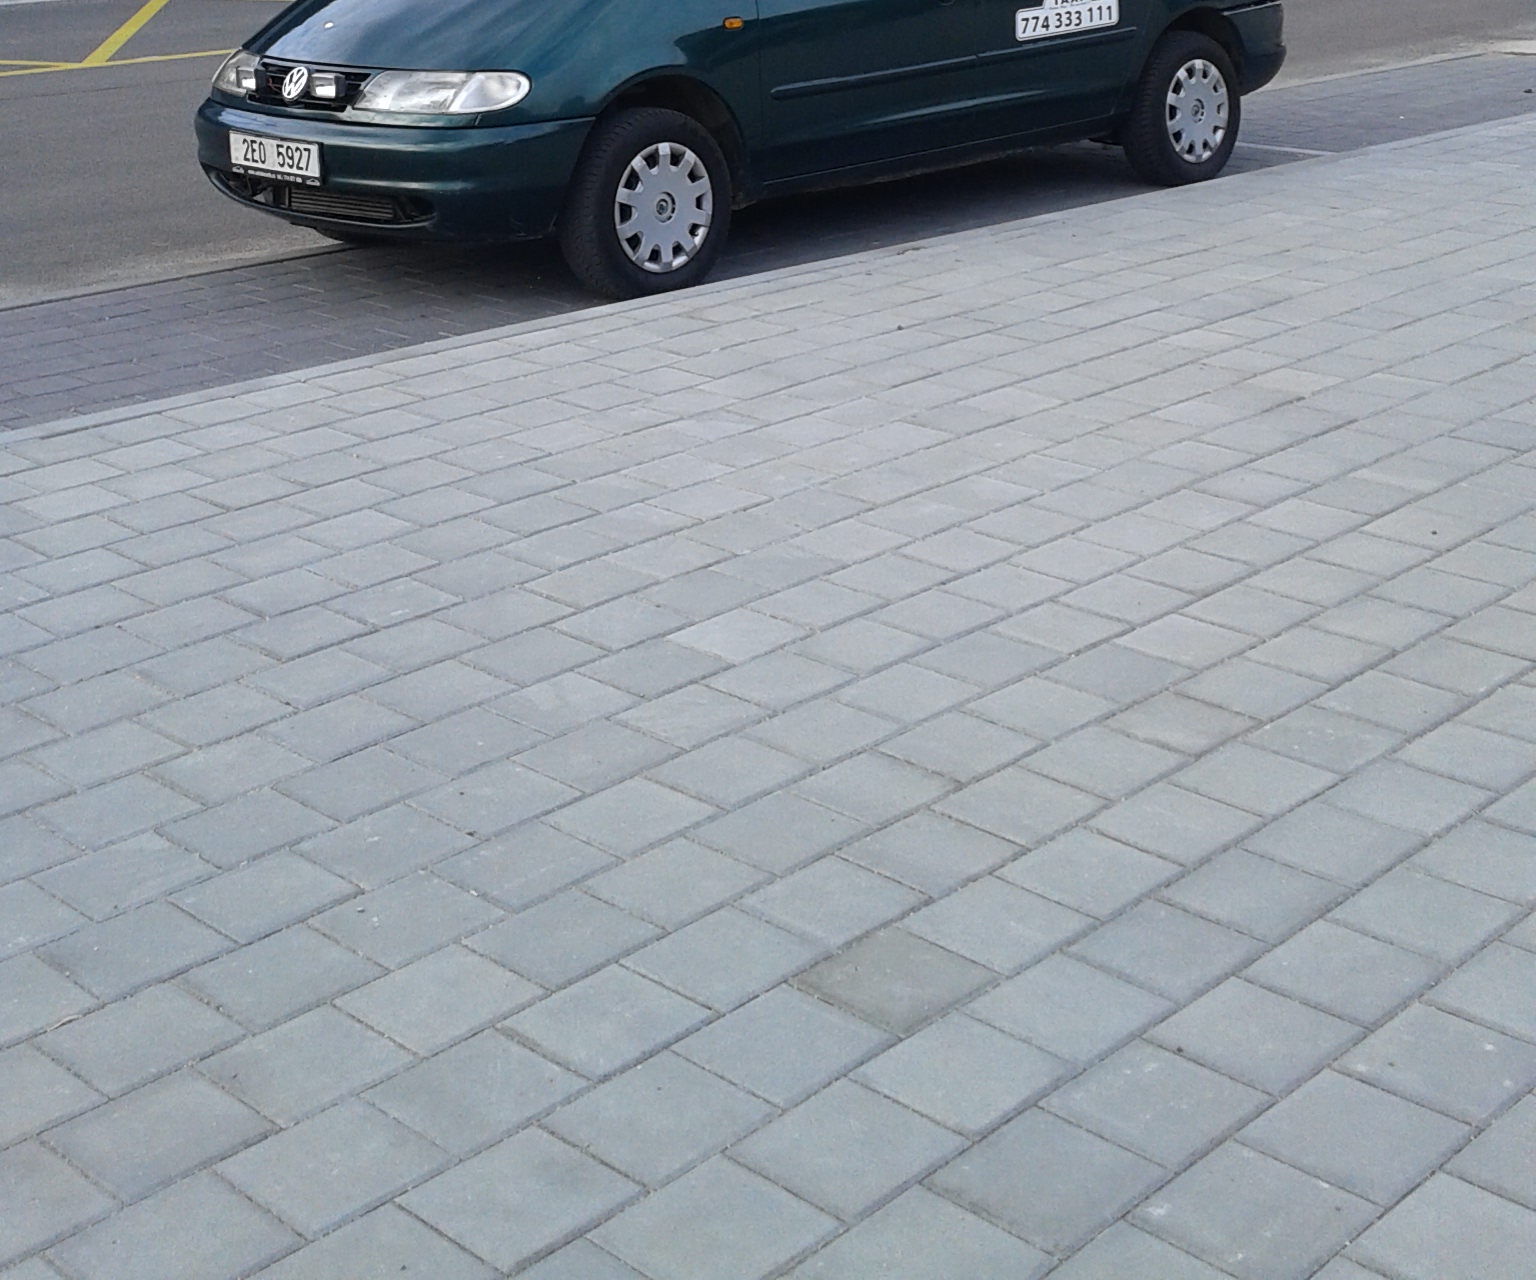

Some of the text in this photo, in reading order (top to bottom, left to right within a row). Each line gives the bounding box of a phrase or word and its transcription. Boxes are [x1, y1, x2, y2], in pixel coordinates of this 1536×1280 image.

[1021, 15, 1050, 34] 774
[1054, 10, 1082, 29] 333
[1087, 5, 1112, 23] 111
[276, 143, 311, 171] 5927
